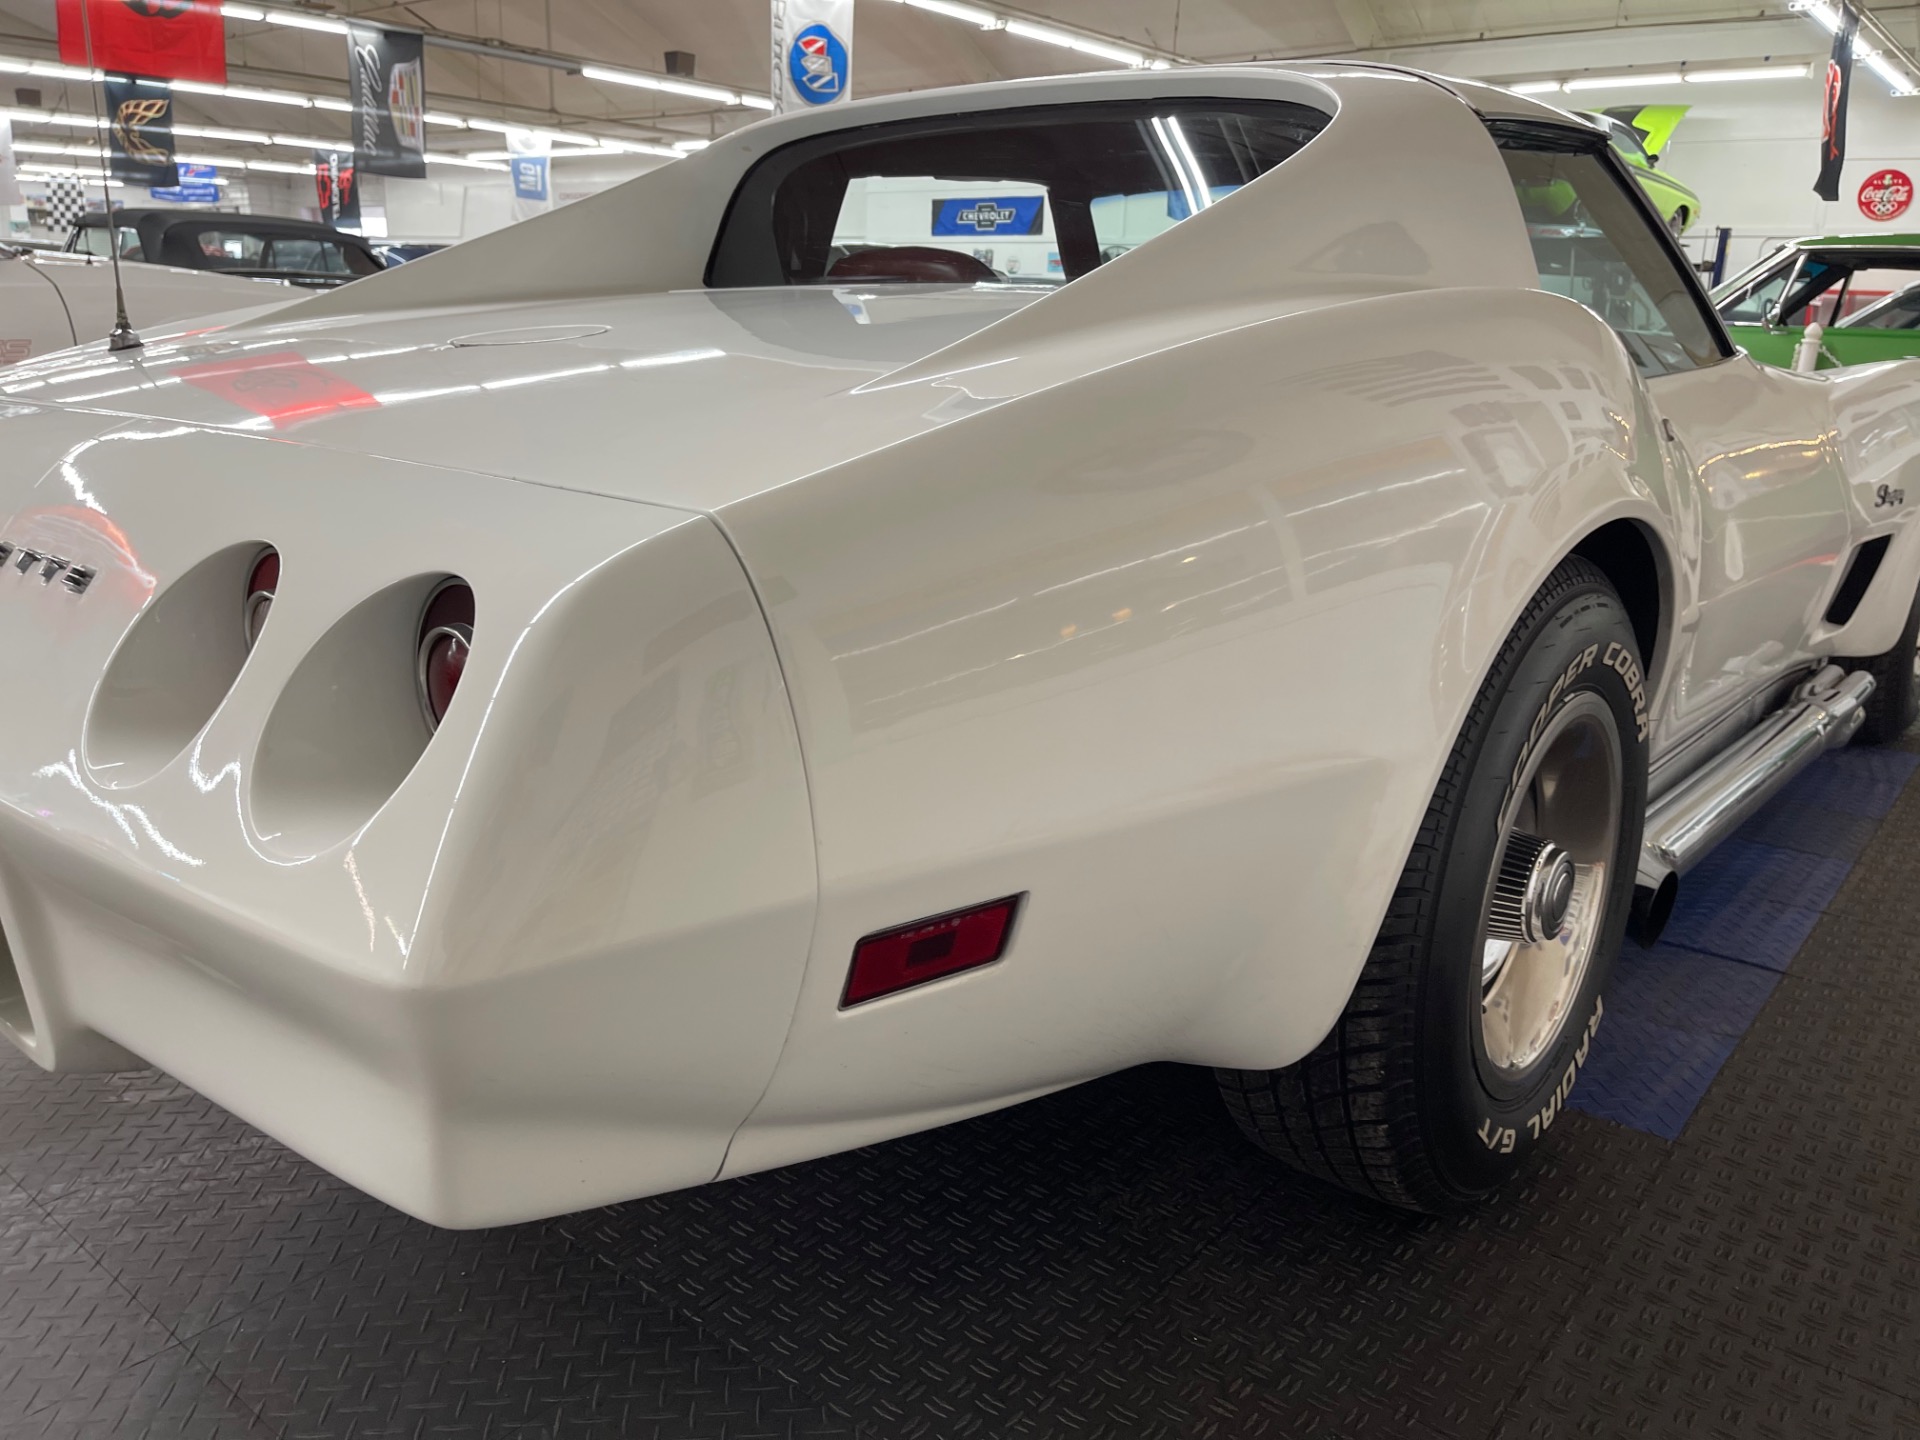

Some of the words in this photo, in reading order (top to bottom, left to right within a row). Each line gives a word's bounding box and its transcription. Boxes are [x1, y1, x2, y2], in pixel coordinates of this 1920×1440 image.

[354, 44, 382, 156] Cadillac
[962, 210, 1010, 221] CHEVROLET
[1602, 641, 1649, 744] COBRA
[1527, 994, 1604, 1140] RADIAL
[1477, 1117, 1516, 1154] G/T
